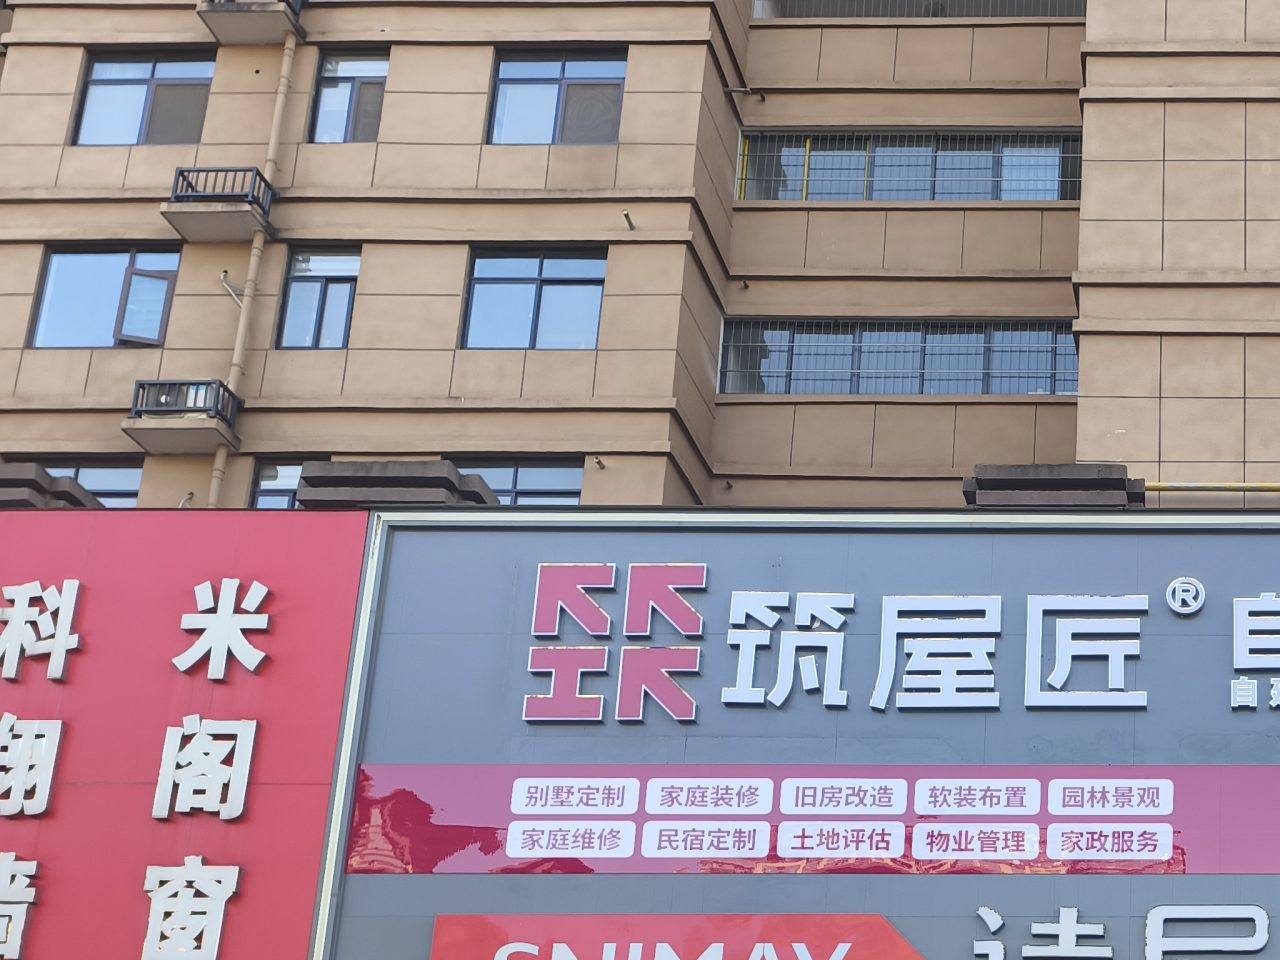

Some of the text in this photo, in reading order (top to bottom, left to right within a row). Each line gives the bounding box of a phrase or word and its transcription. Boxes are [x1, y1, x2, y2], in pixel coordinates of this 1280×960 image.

[720, 590, 1149, 710] 筑屋匠
[525, 785, 626, 808] 别墅定制
[659, 785, 760, 808] 家庭装修
[794, 785, 894, 809] 旧房改造
[928, 785, 1028, 809] 软装布置
[1061, 786, 1161, 809] 园林景观
[521, 827, 622, 851] 家庭维修
[656, 828, 757, 851] 民宿定制
[790, 828, 892, 852] 土地评估
[925, 829, 1026, 853] 物业管理
[1060, 830, 1160, 854] 家政服务
